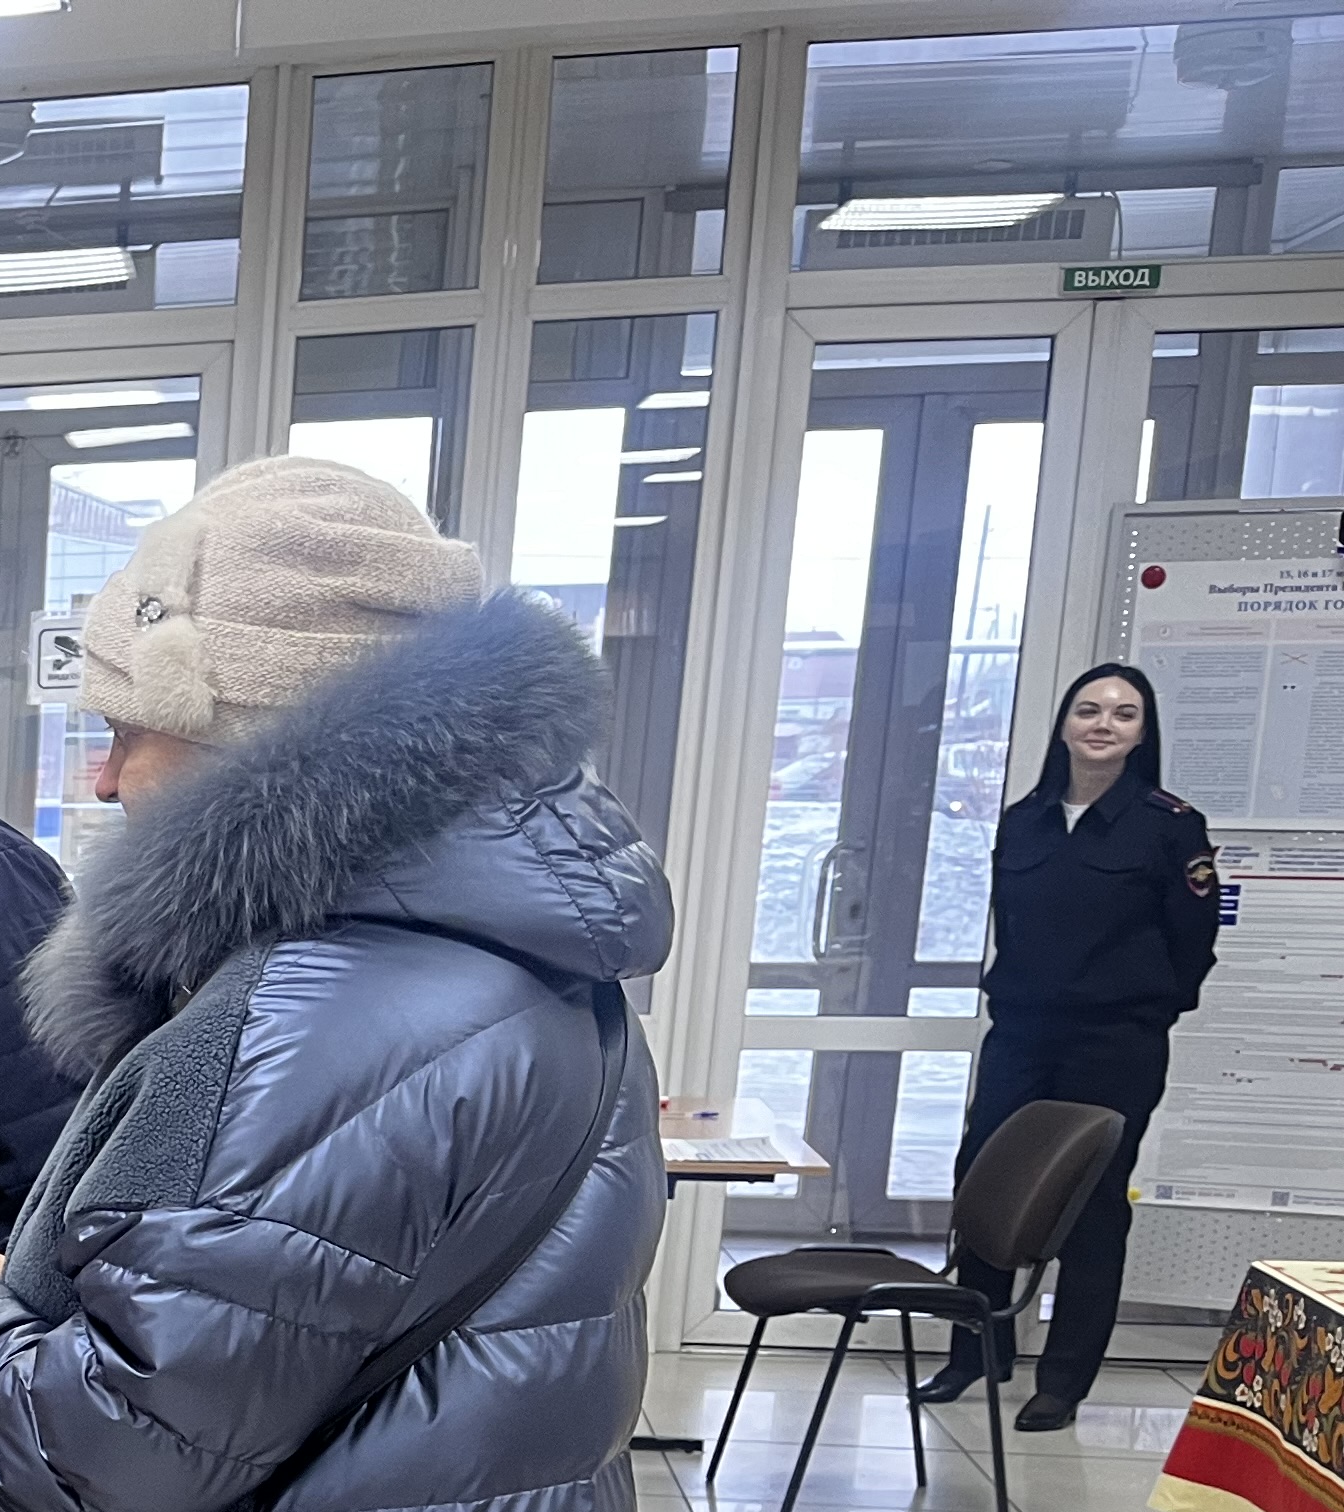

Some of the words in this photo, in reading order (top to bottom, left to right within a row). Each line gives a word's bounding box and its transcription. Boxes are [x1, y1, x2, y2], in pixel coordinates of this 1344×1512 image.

[1074, 268, 1150, 286] ВЫХОД
[1208, 583, 1260, 596] Выборы
[1263, 582, 1338, 596] Президента
[1237, 599, 1319, 613] ПОРЯДОК
